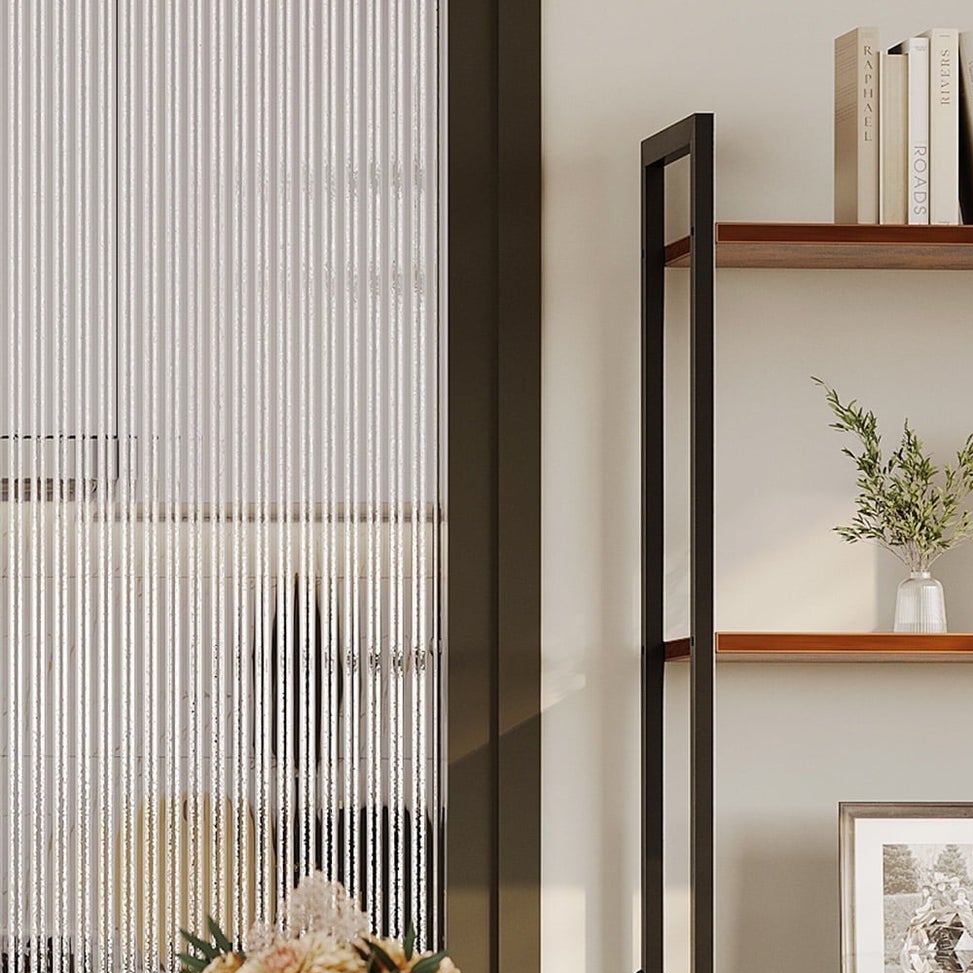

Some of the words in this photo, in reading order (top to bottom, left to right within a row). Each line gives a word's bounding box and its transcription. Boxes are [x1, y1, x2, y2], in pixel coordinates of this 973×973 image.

[863, 45, 873, 142] RAPHAEL
[940, 49, 951, 105] RIVERS
[913, 146, 928, 215] ROADS
